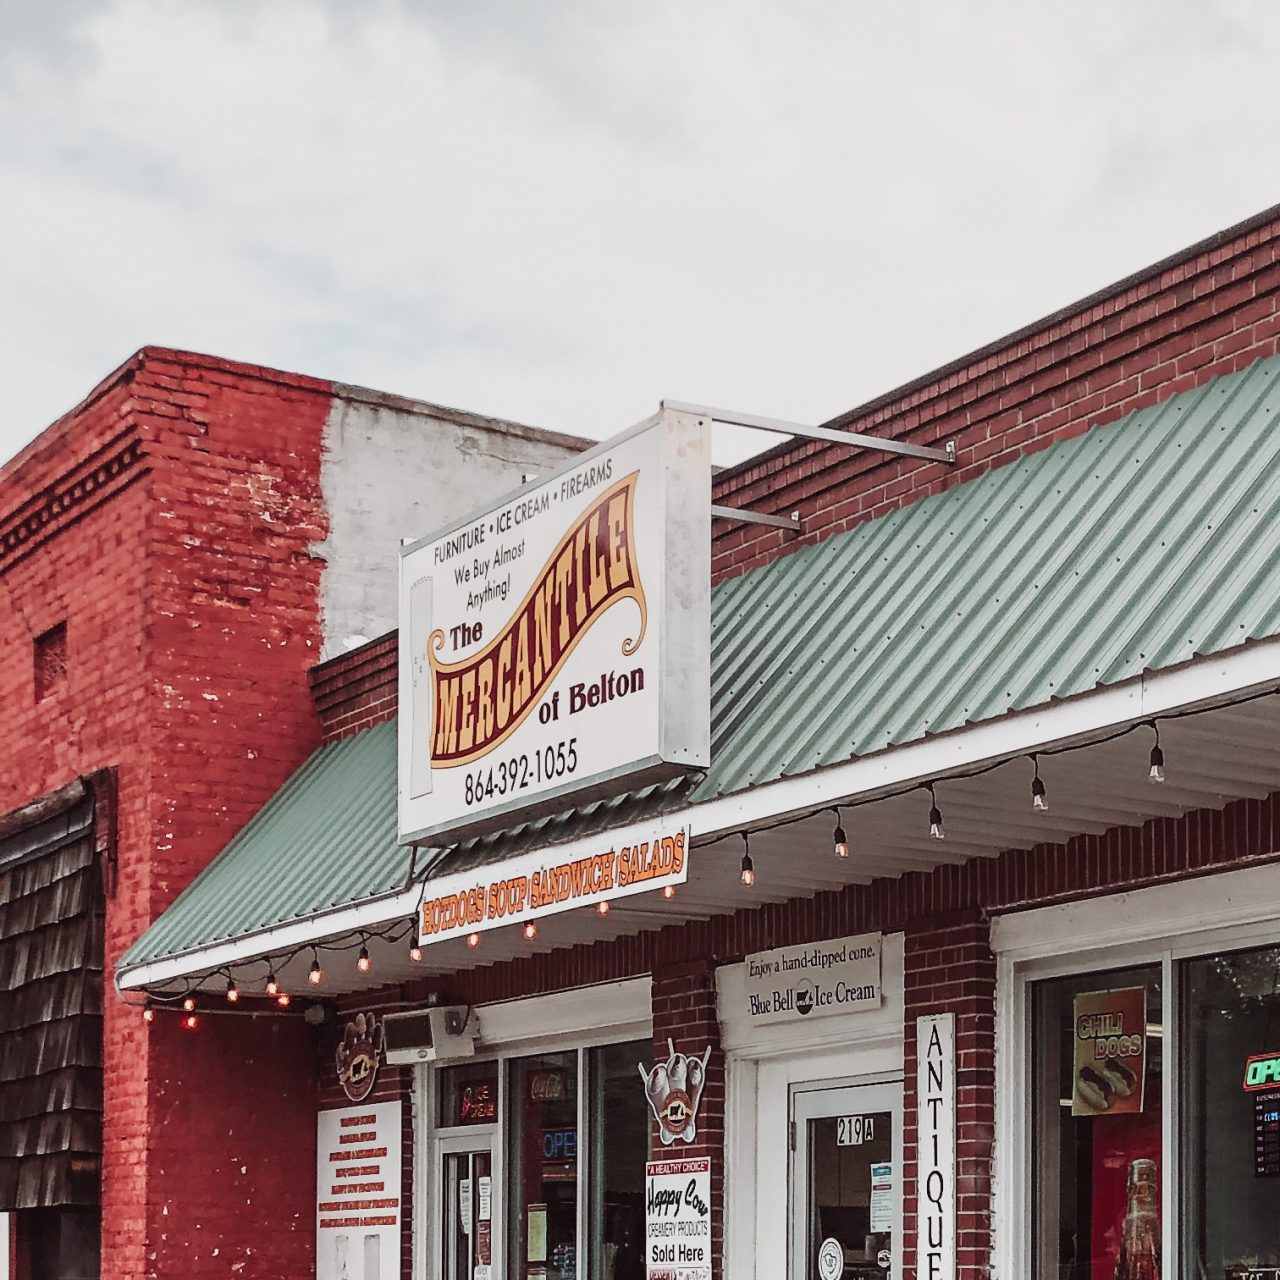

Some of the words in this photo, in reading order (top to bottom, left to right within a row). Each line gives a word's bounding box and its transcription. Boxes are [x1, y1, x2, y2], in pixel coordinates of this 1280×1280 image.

[434, 524, 485, 566] FURNITURE
[496, 511, 513, 536] ICE
[514, 495, 550, 529] CREAM
[561, 459, 613, 503] FIREARMS
[455, 566, 470, 585] We
[473, 558, 490, 582] Buy
[494, 539, 526, 571] Almost
[466, 573, 511, 612] Anything!
[436, 497, 631, 755] MERCANTILE
[449, 620, 483, 652] The
[538, 692, 560, 725] of
[569, 667, 645, 715] Belton
[465, 738, 578, 806] 864-392-1055
[422, 885, 485, 935] HOTDOGS
[487, 876, 528, 920] SOUP
[531, 852, 615, 909] SANDWICH
[618, 832, 686, 887] SALADS
[749, 959, 772, 978] Enjoy
[775, 963, 780, 973] a
[782, 946, 846, 971] hand-dipped
[849, 946, 875, 961] cone.
[750, 993, 771, 1016] Blue
[773, 989, 793, 1012] Bell
[815, 985, 832, 1007] Ice
[836, 982, 875, 1003] Cream
[1077, 1012, 1123, 1041] CHILI
[1094, 1035, 1142, 1060] DOGS
[543, 1132, 577, 1157] OPE
[655, 1163, 681, 1174] HEALTHY
[648, 1177, 682, 1217] Happy
[685, 1178, 708, 1217] Cow
[678, 1220, 708, 1237] PRODUCTS
[652, 1244, 675, 1263] Sold
[679, 1243, 704, 1262] Here
